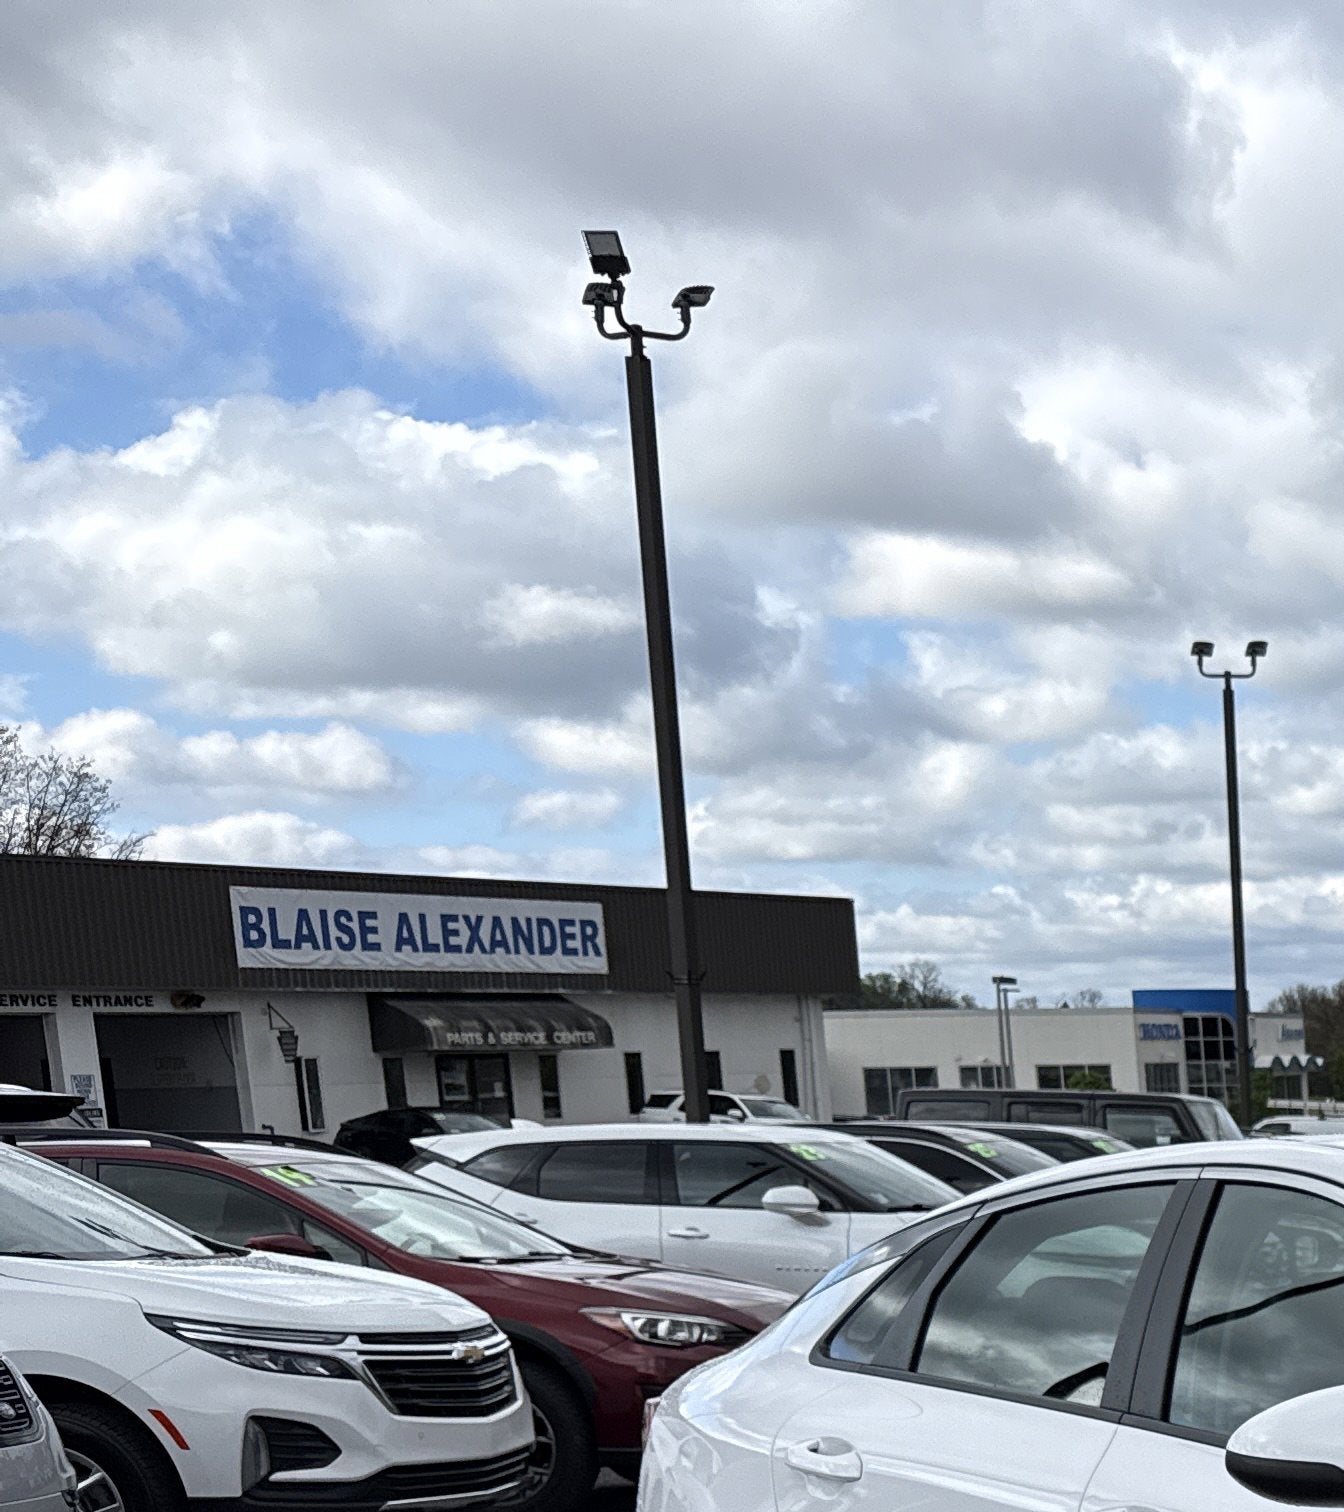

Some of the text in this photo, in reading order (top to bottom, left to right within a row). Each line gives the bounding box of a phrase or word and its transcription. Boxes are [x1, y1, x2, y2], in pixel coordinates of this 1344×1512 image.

[238, 905, 604, 958] BLAISE ALEXANDER
[71, 994, 155, 1008] ENTRANCE
[446, 1031, 597, 1046] PARTS & SERVICE CENTER
